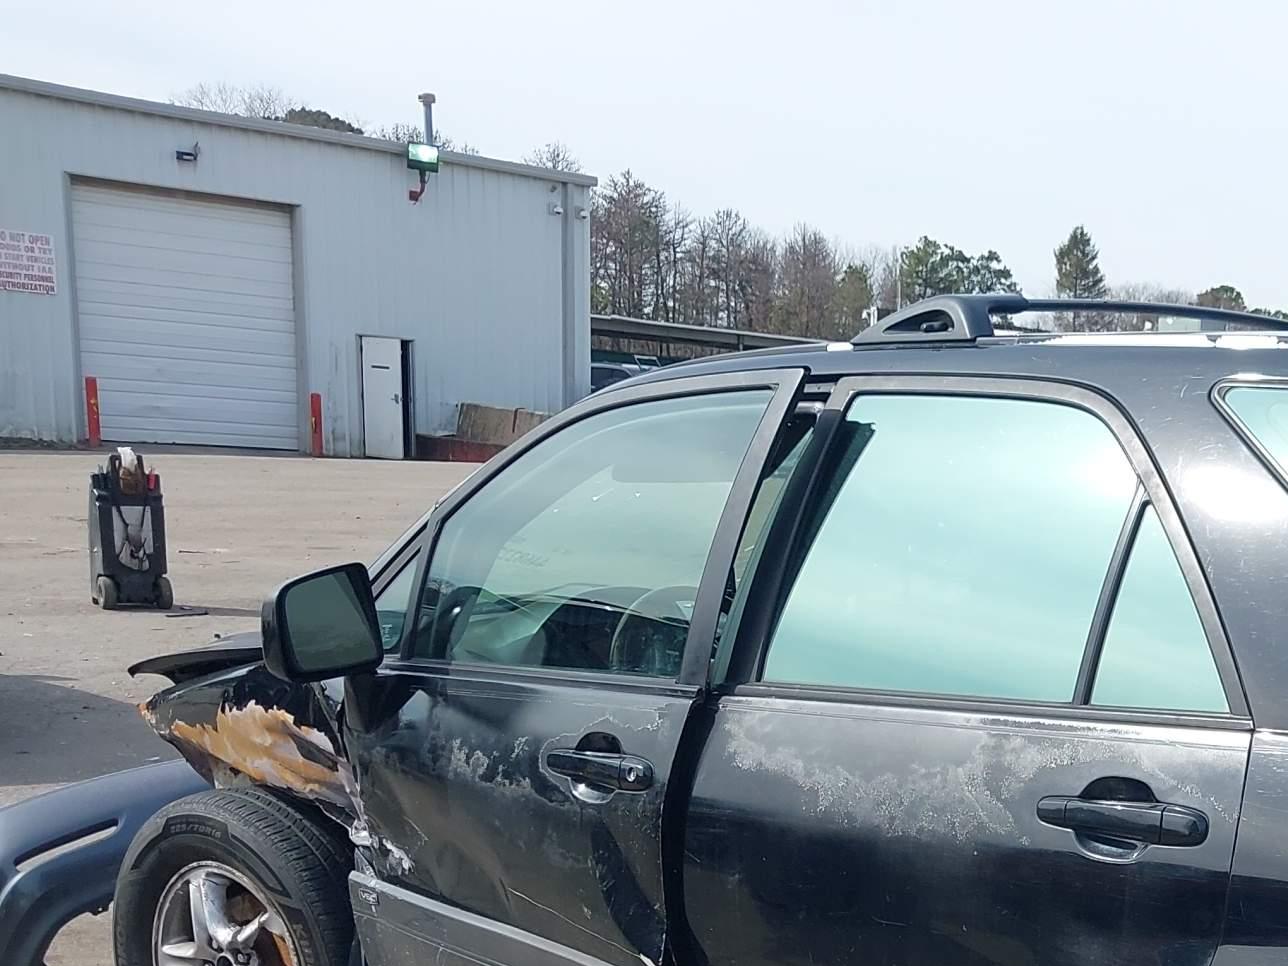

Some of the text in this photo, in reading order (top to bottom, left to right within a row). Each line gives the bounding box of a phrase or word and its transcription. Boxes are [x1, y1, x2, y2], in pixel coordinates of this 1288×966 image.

[9, 232, 25, 243] NOT
[28, 234, 50, 246] OPEN
[24, 245, 35, 253] OR
[26, 255, 54, 265] VEHICLES
